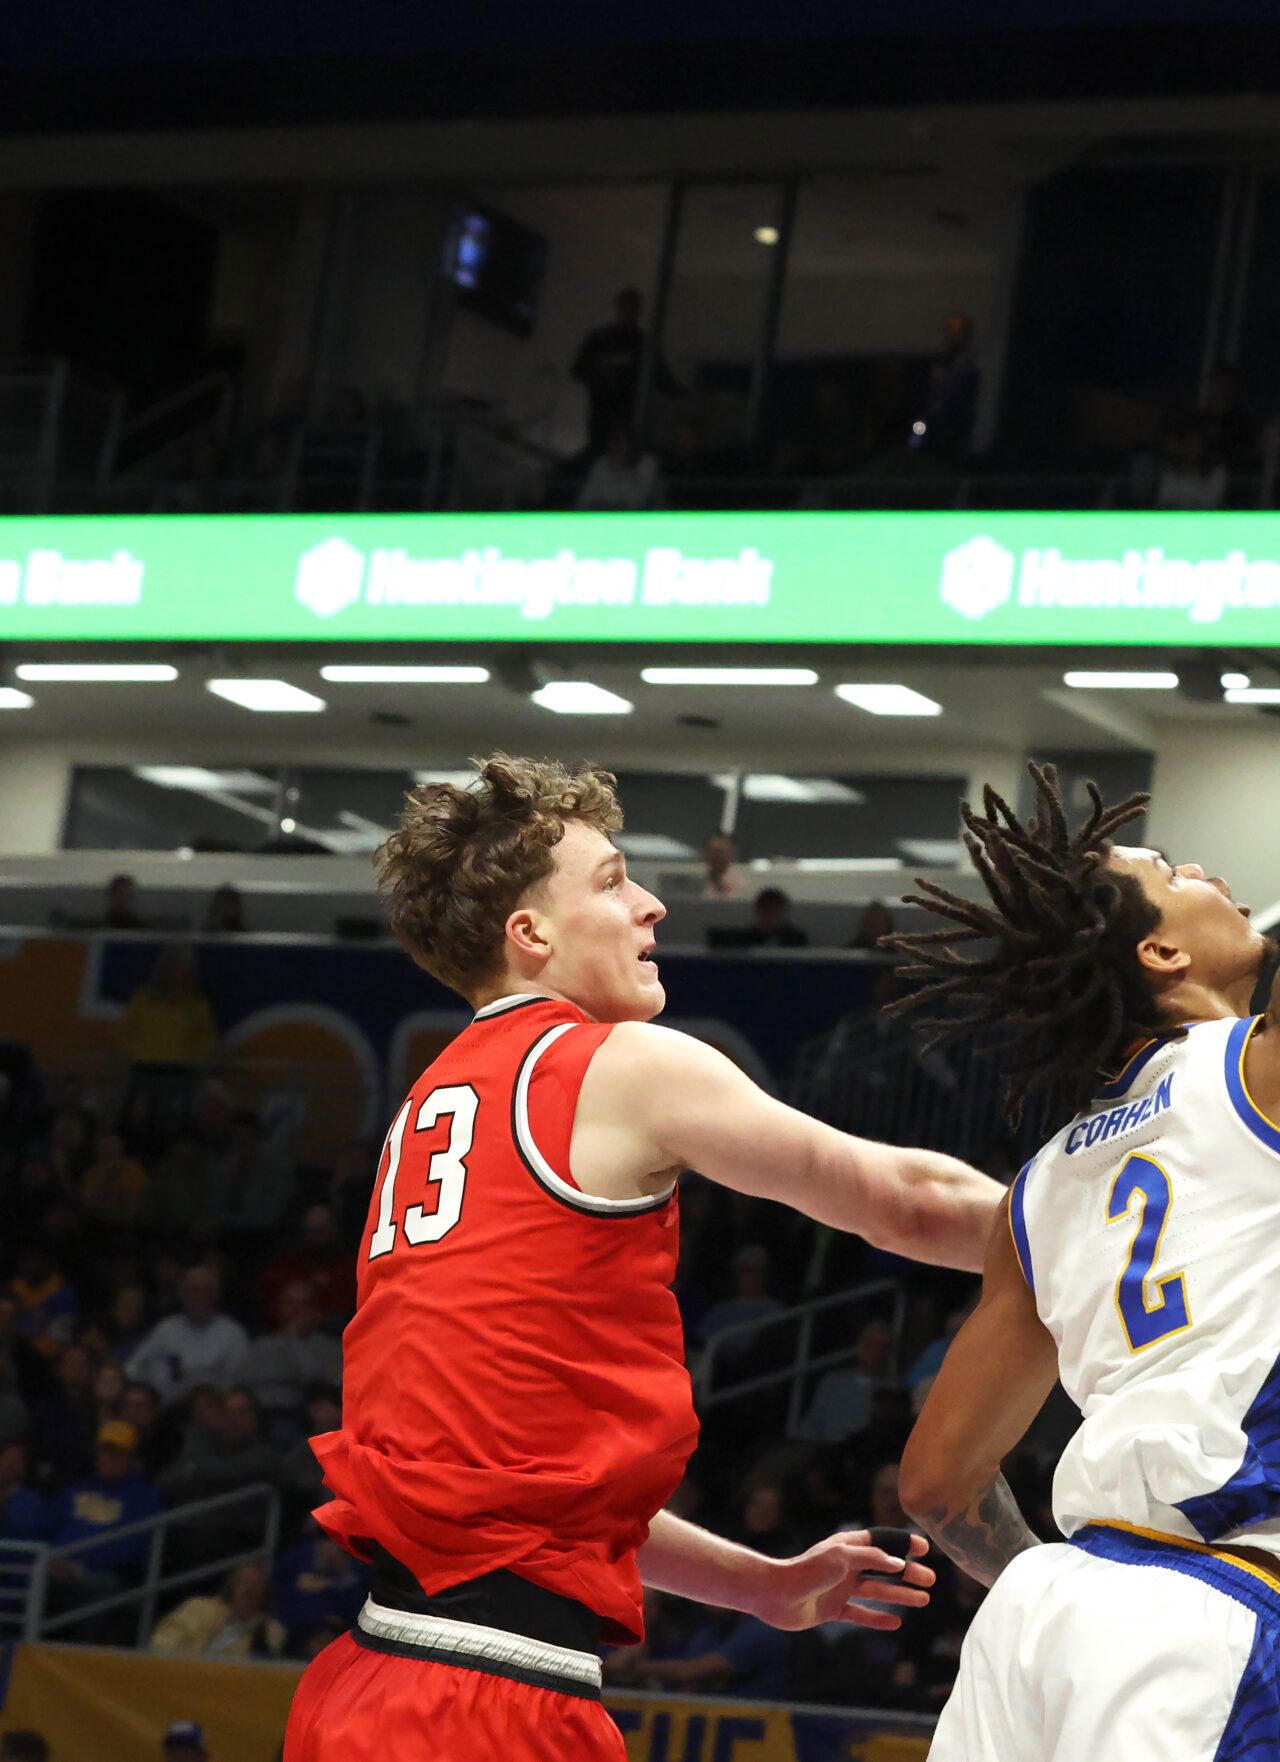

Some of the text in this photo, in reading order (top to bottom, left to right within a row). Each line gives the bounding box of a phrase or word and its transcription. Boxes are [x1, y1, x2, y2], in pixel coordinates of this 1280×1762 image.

[24, 549, 146, 606] Bank
[367, 546, 774, 620] Huntington Bank
[367, 1081, 481, 1263] 13
[1105, 1152, 1193, 1355] 2
